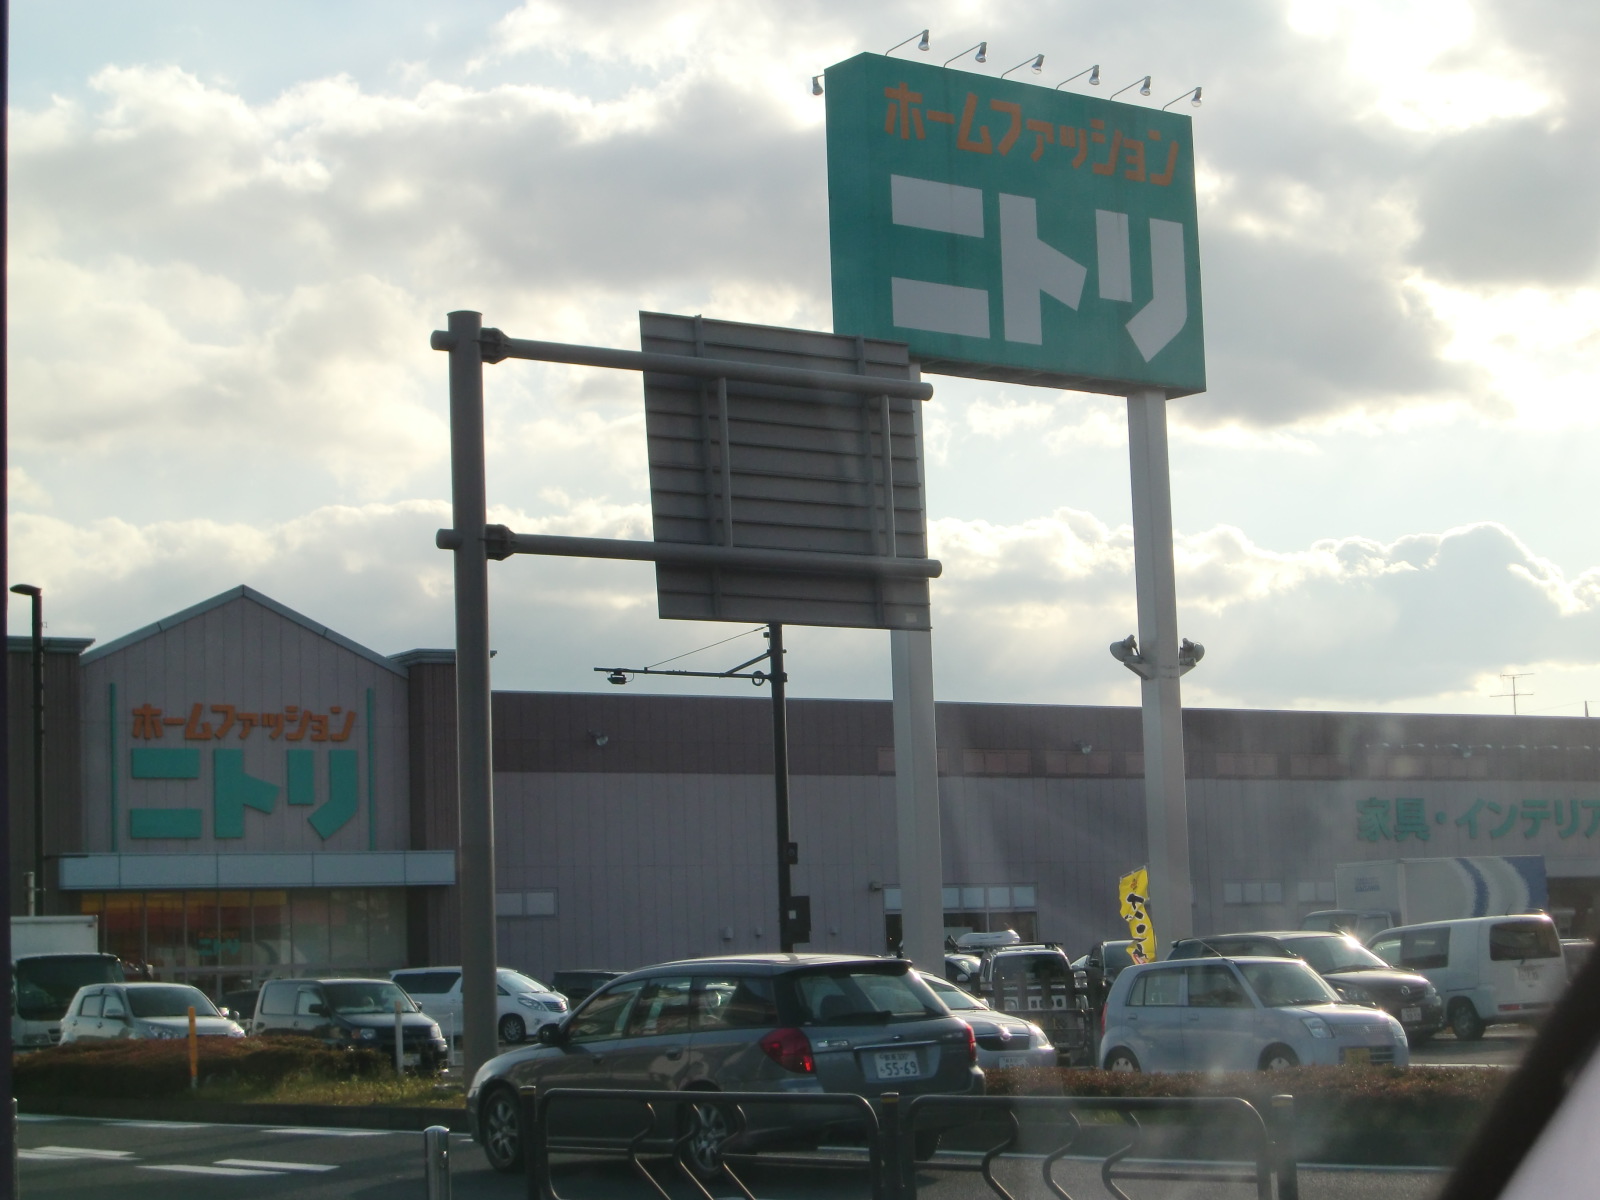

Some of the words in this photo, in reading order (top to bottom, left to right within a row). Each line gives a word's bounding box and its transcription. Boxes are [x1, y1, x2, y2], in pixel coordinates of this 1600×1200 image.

[884, 82, 1180, 188] ホームファッション
[891, 173, 1188, 363] ニトリ
[132, 702, 357, 742] ホームファッション
[130, 747, 359, 840] ニトリ
[1355, 797, 1600, 842] 家具・インテリア
